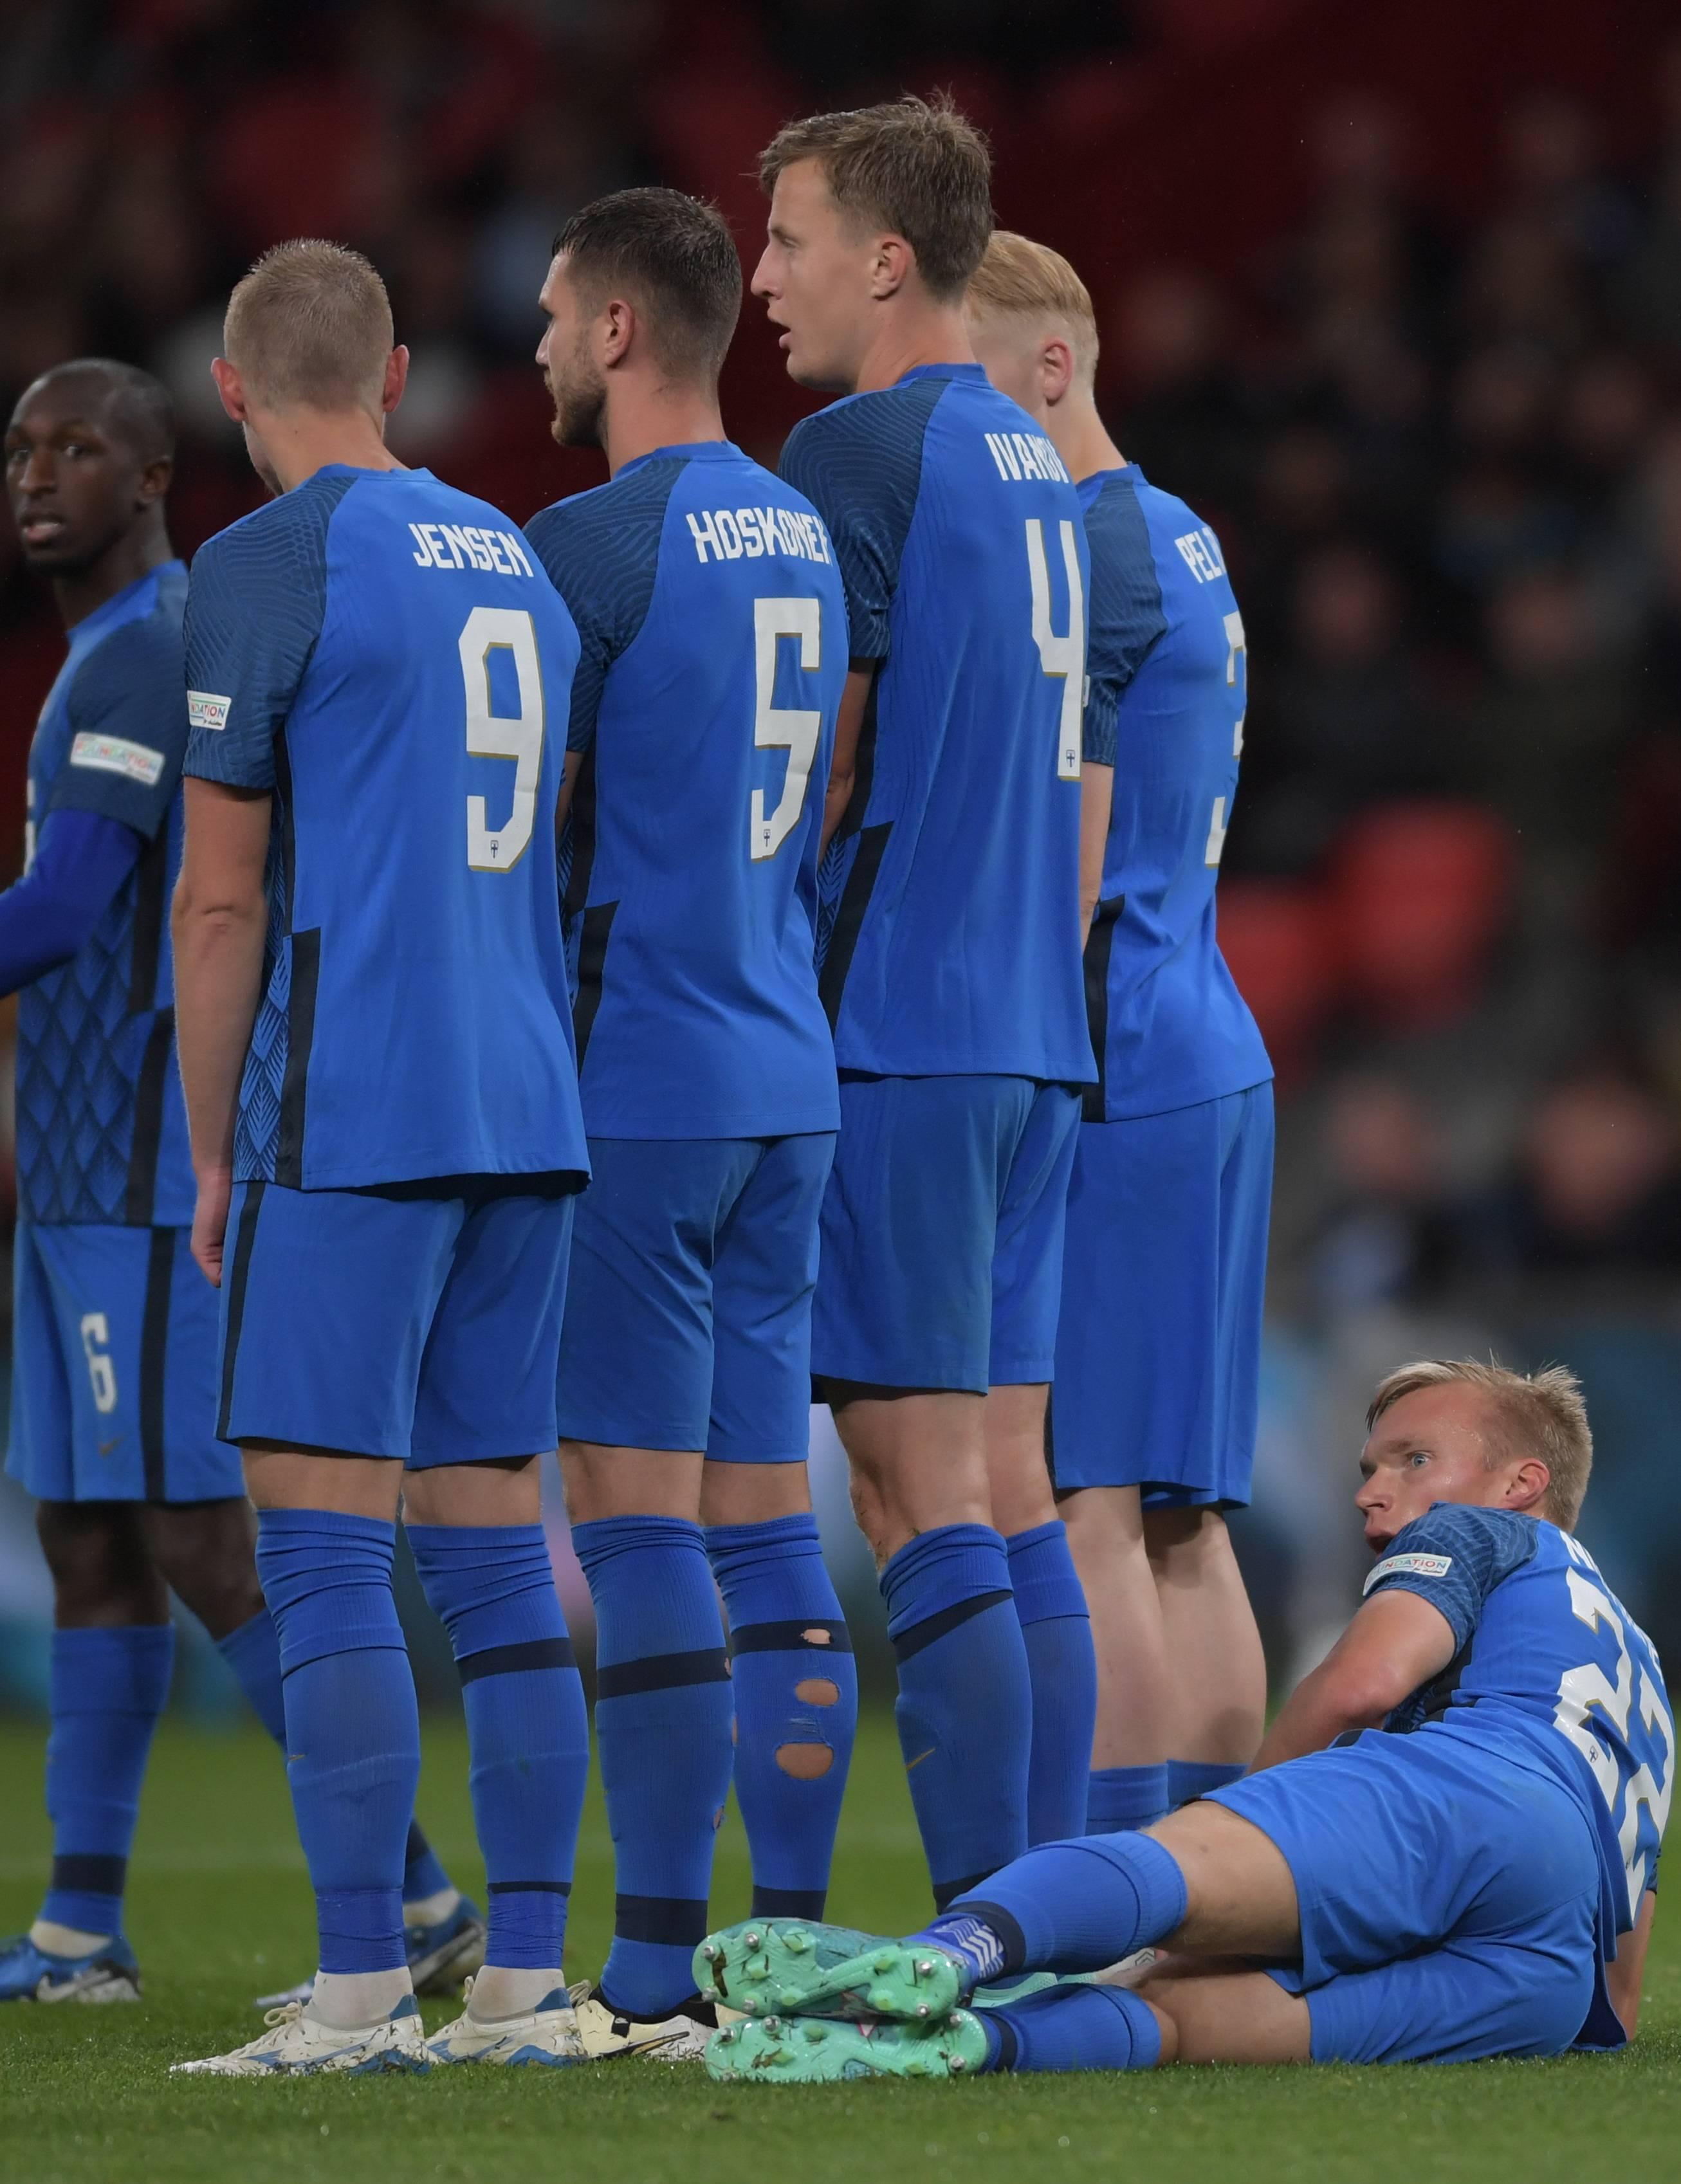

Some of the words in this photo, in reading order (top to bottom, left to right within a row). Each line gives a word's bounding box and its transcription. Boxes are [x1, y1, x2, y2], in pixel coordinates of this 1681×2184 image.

[407, 523, 535, 578] JENSEN
[1025, 519, 1083, 780] 4
[458, 607, 545, 872] 9
[751, 598, 821, 862] 5
[80, 1312, 117, 1413] 6
